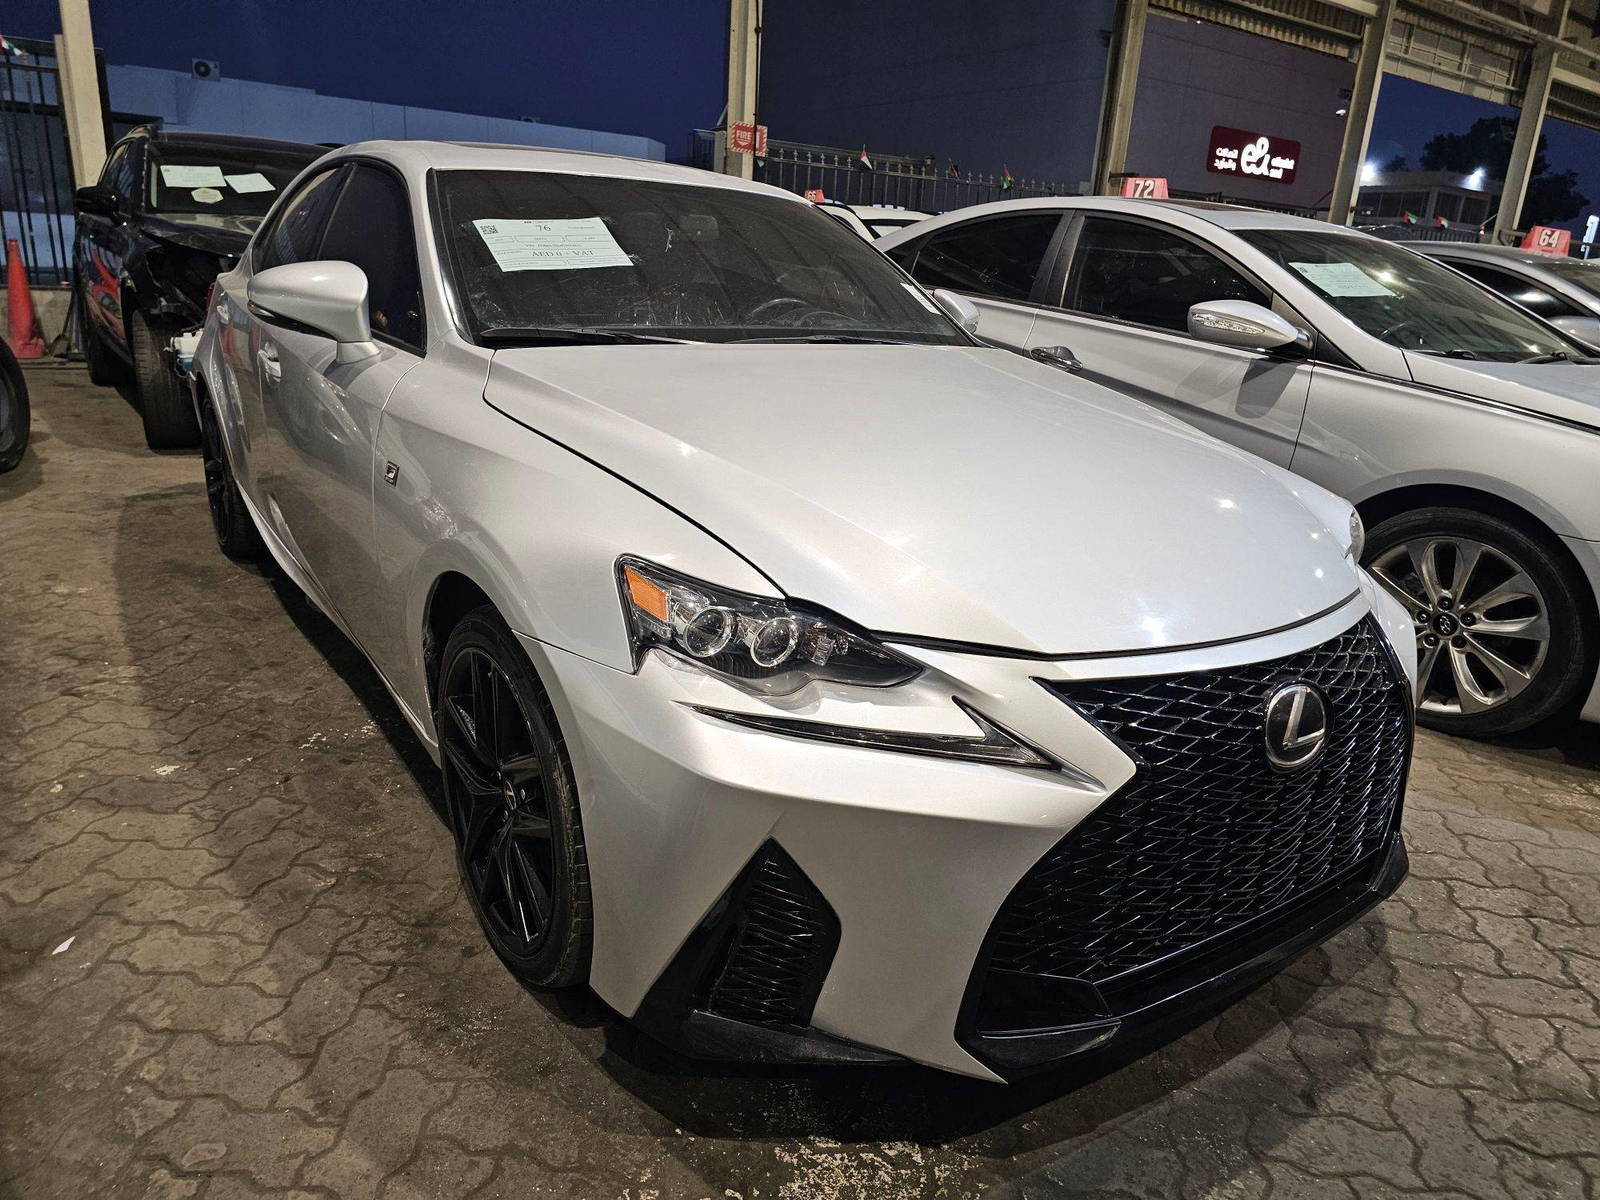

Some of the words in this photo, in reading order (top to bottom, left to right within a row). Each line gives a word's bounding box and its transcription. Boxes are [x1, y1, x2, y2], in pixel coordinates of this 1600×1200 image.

[736, 130, 753, 140] FIRE
[1134, 179, 1155, 198] 72
[1538, 228, 1561, 248] 64
